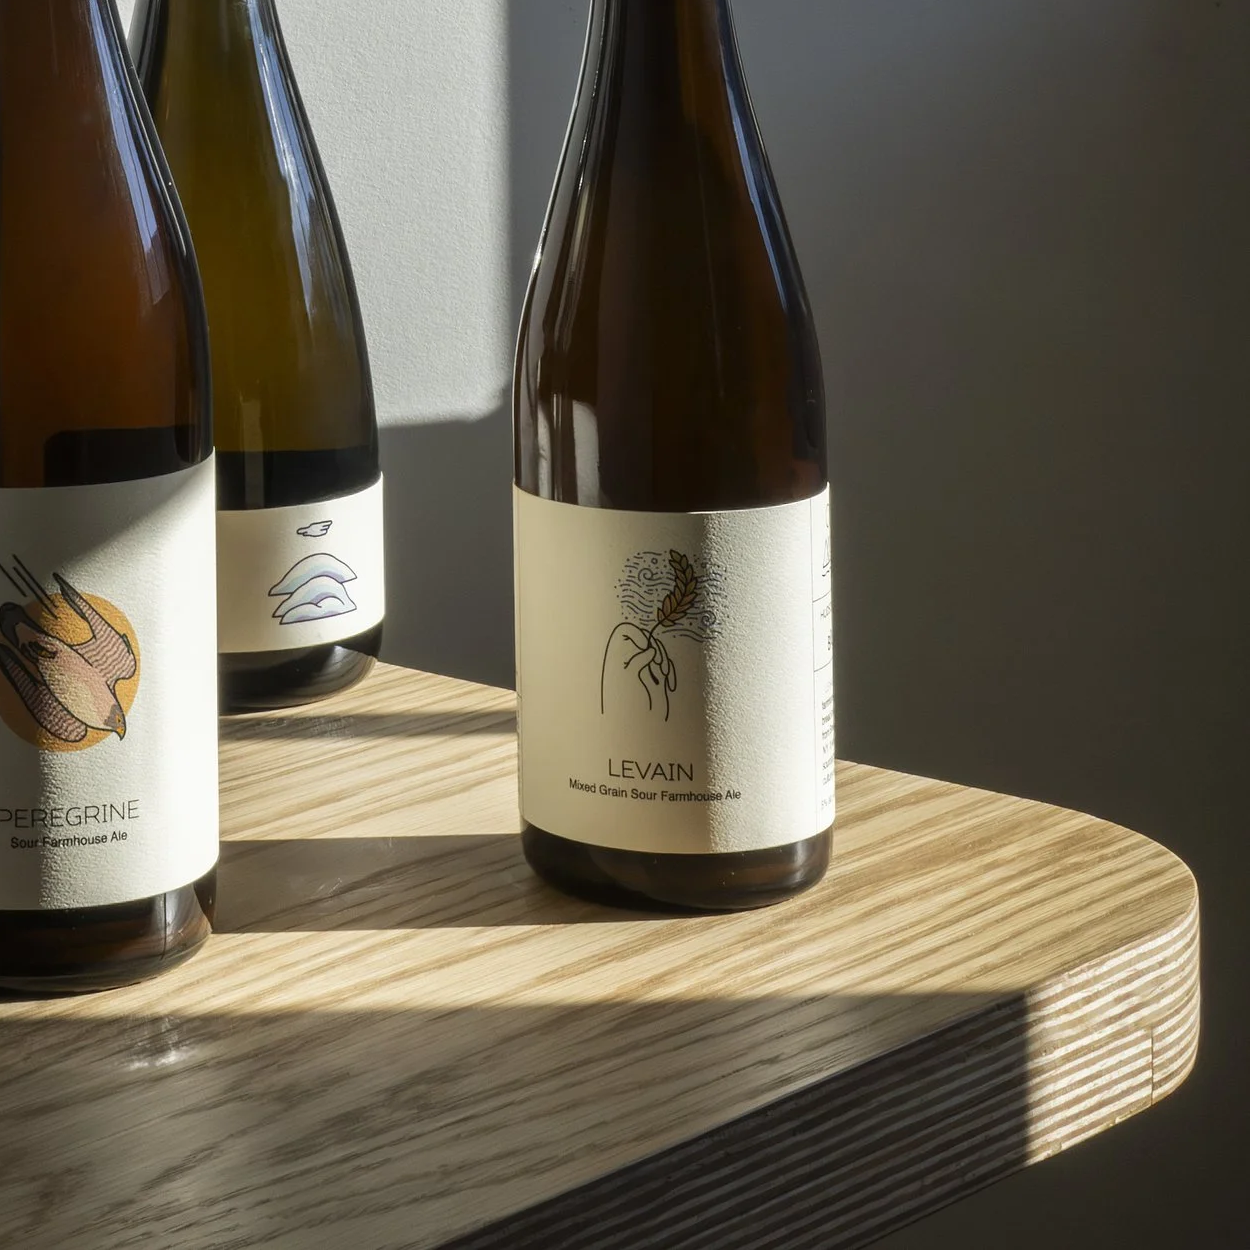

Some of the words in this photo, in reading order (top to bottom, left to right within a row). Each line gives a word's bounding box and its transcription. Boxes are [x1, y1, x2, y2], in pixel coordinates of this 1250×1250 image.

[608, 758, 694, 781] LEVAIN
[569, 778, 597, 793] Mixed
[599, 784, 627, 798] Grain
[631, 788, 657, 800] Sour
[661, 790, 723, 802] Farmhouse
[725, 789, 742, 800] Ale
[10, 836, 39, 849] Sour
[42, 835, 108, 848] Farmhouse
[110, 830, 128, 843] Ale
